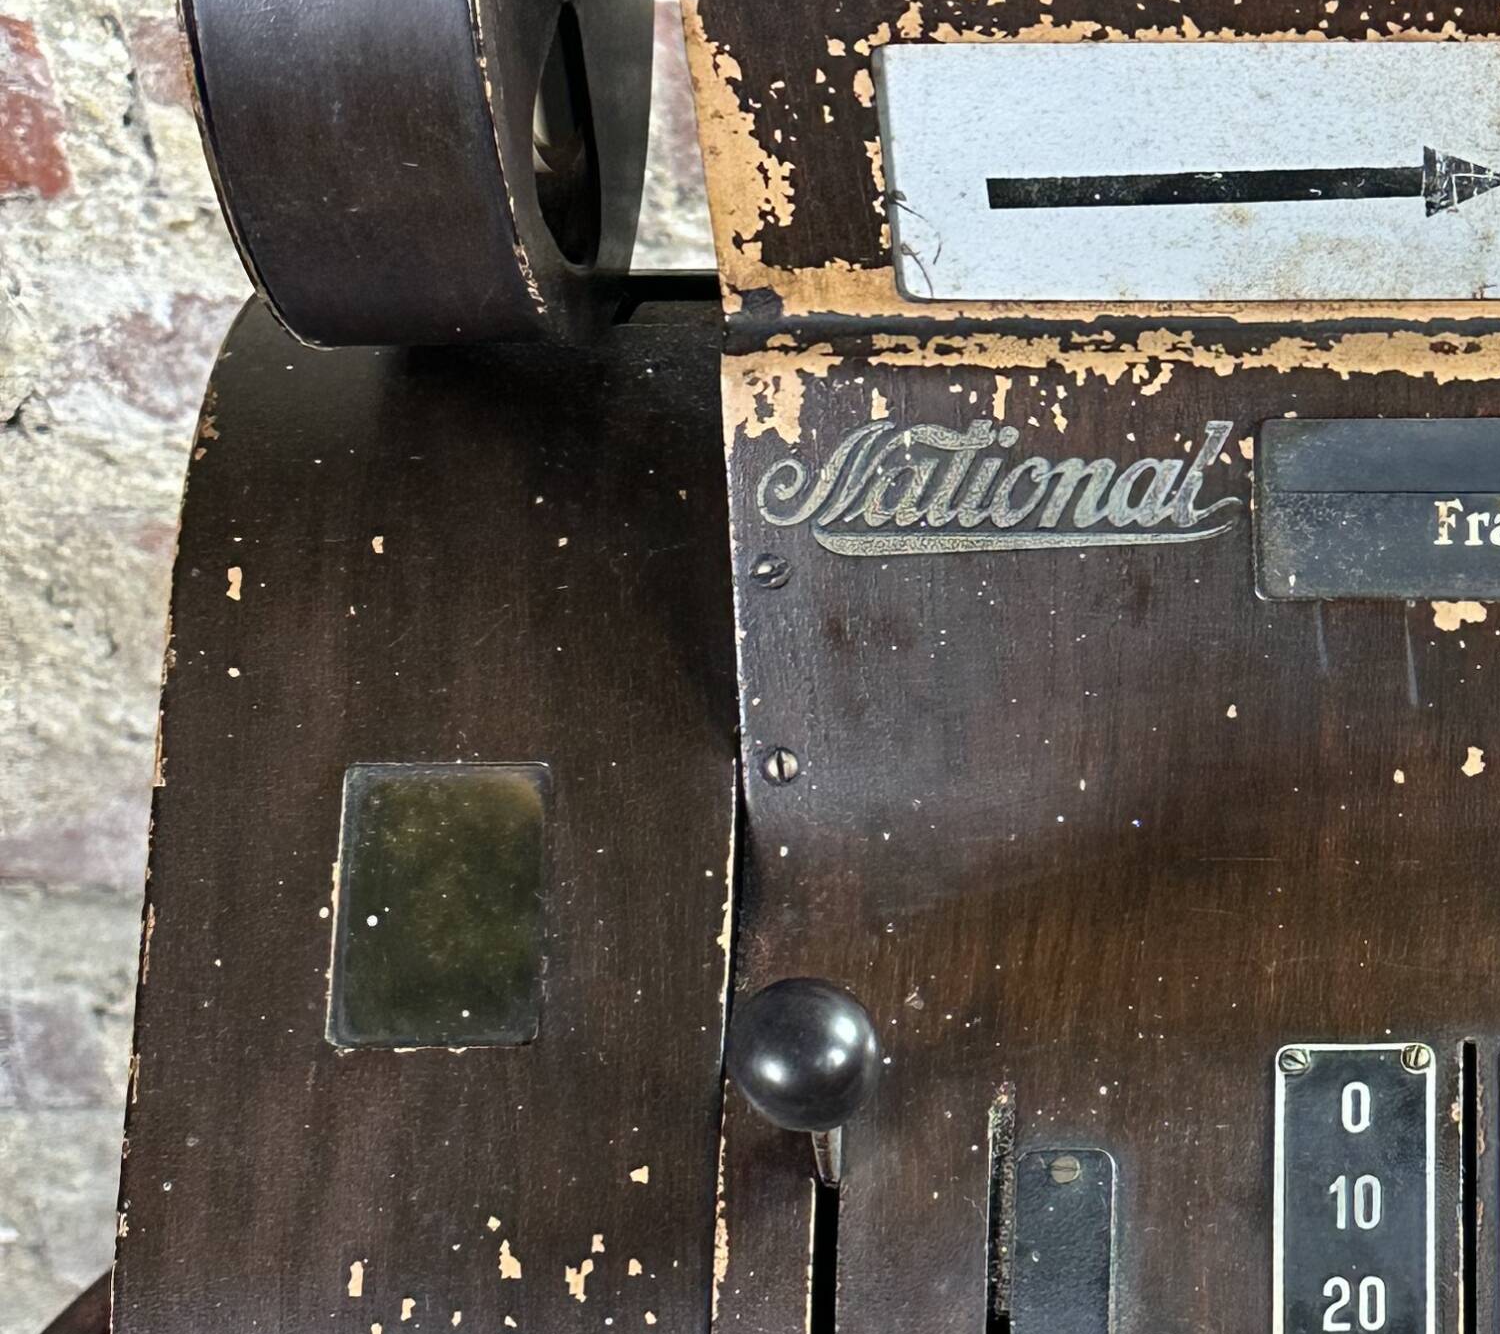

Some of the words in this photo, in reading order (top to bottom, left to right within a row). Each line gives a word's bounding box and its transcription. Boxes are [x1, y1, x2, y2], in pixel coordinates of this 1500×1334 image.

[757, 419, 1244, 528] National
[1341, 1081, 1371, 1134] 0
[1328, 1175, 1382, 1230] 10
[1322, 1275, 1386, 1332] 20
